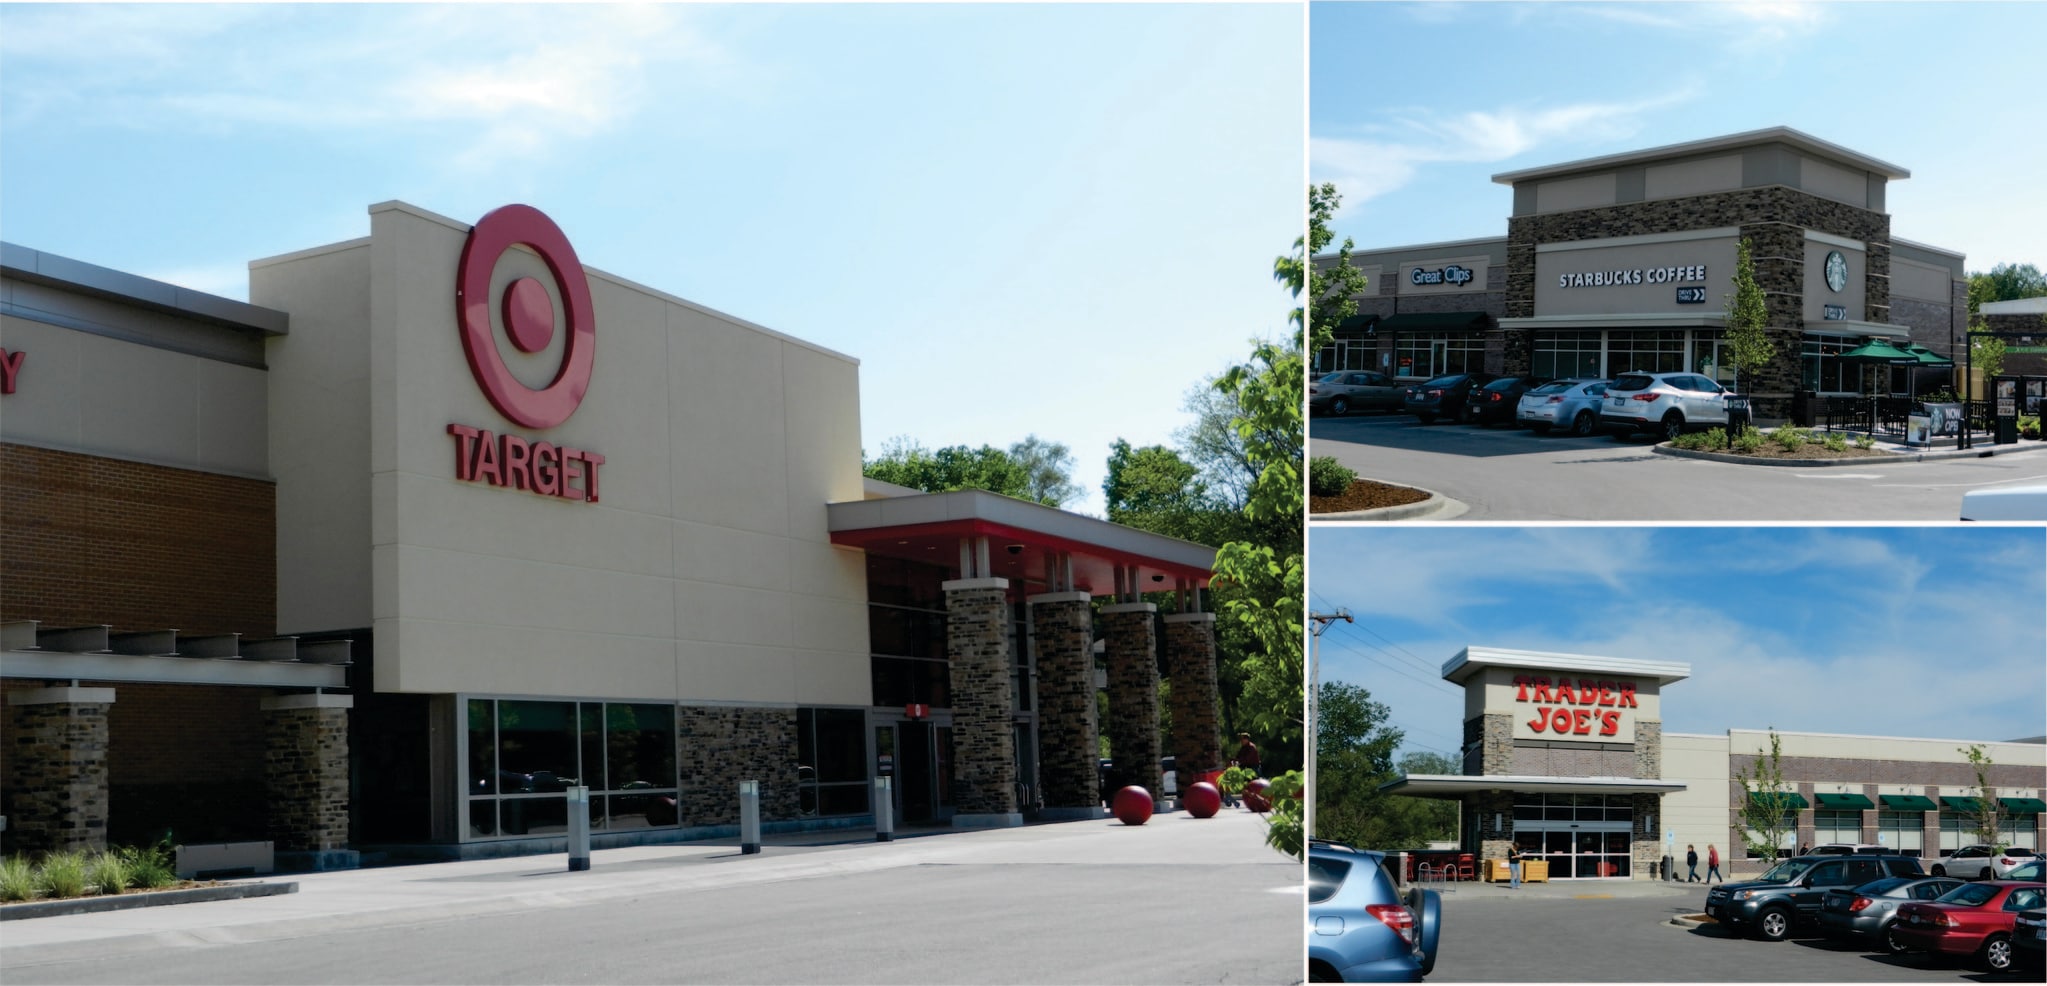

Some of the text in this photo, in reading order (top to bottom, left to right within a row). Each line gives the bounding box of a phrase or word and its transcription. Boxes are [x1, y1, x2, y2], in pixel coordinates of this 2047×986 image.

[1411, 266, 1472, 286] Great Clips
[1560, 265, 1706, 288] STARBUCKS COFFEE
[1945, 408, 1961, 420] NOW
[447, 424, 606, 502] TARGET
[1512, 675, 1638, 709] TRADER
[1527, 707, 1622, 736] JOE'S
